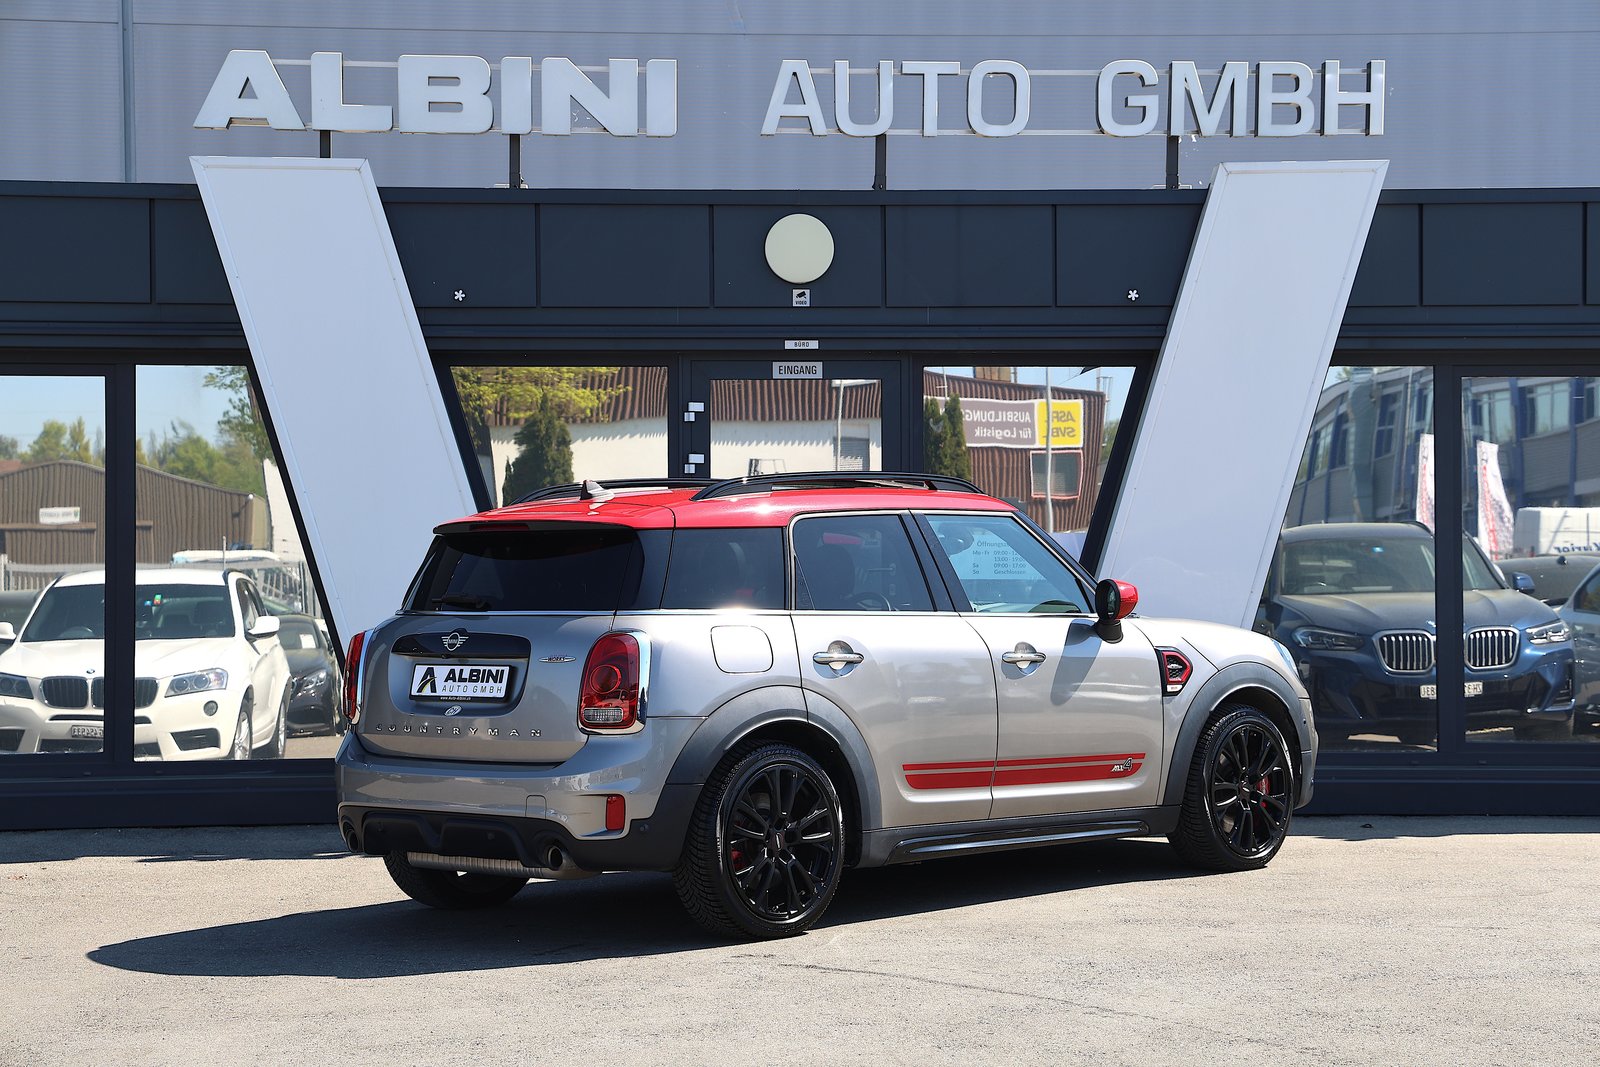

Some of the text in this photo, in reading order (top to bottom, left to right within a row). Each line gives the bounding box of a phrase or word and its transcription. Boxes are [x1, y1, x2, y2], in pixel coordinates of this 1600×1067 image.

[193, 48, 1387, 137] ALBINI AUTO GMBH
[794, 340, 810, 348] BÜRO
[778, 365, 817, 375] EINGANG
[443, 667, 505, 684] ALBINI
[441, 685, 503, 694] AUTO GMBH
[375, 722, 542, 738] COUNTRYMAN
